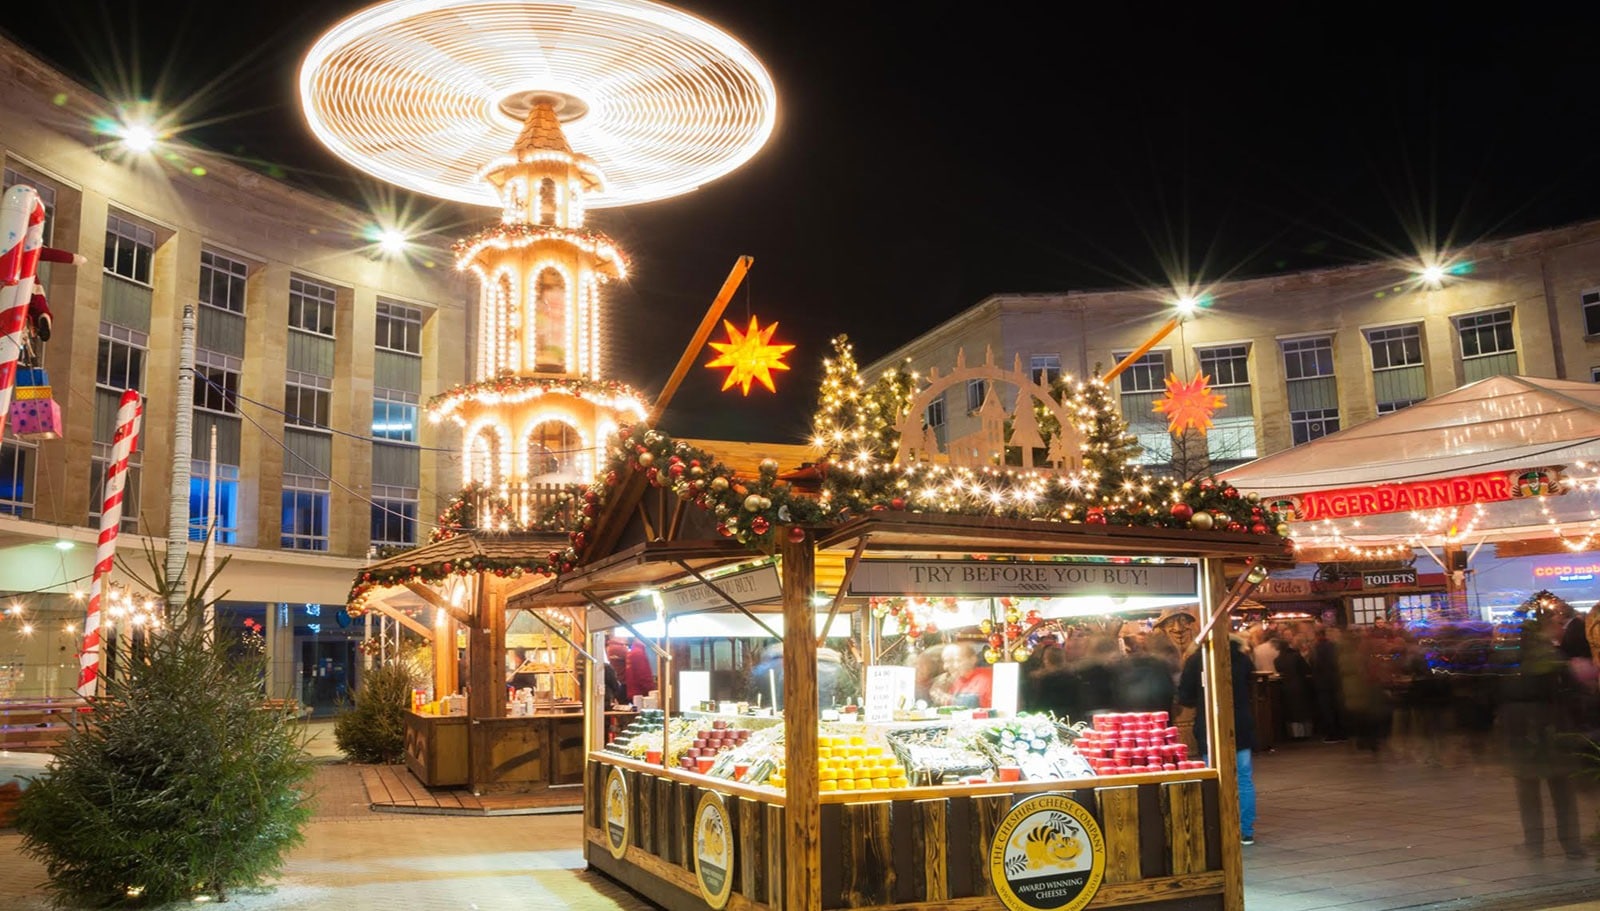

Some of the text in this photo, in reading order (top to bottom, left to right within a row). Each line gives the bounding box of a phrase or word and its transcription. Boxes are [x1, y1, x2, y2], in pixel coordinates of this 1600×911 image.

[1377, 484, 1449, 512] BARN
[1453, 478, 1509, 503] BAR
[909, 565, 1149, 586] TRY BEFORE YOU BUY!
[1364, 573, 1415, 586] TOILETS
[993, 798, 1103, 866] THE CHESHIRE CHEESE COMPANY
[1018, 877, 1084, 894] AWARD WINNING
[1035, 888, 1067, 900] CHEESES
